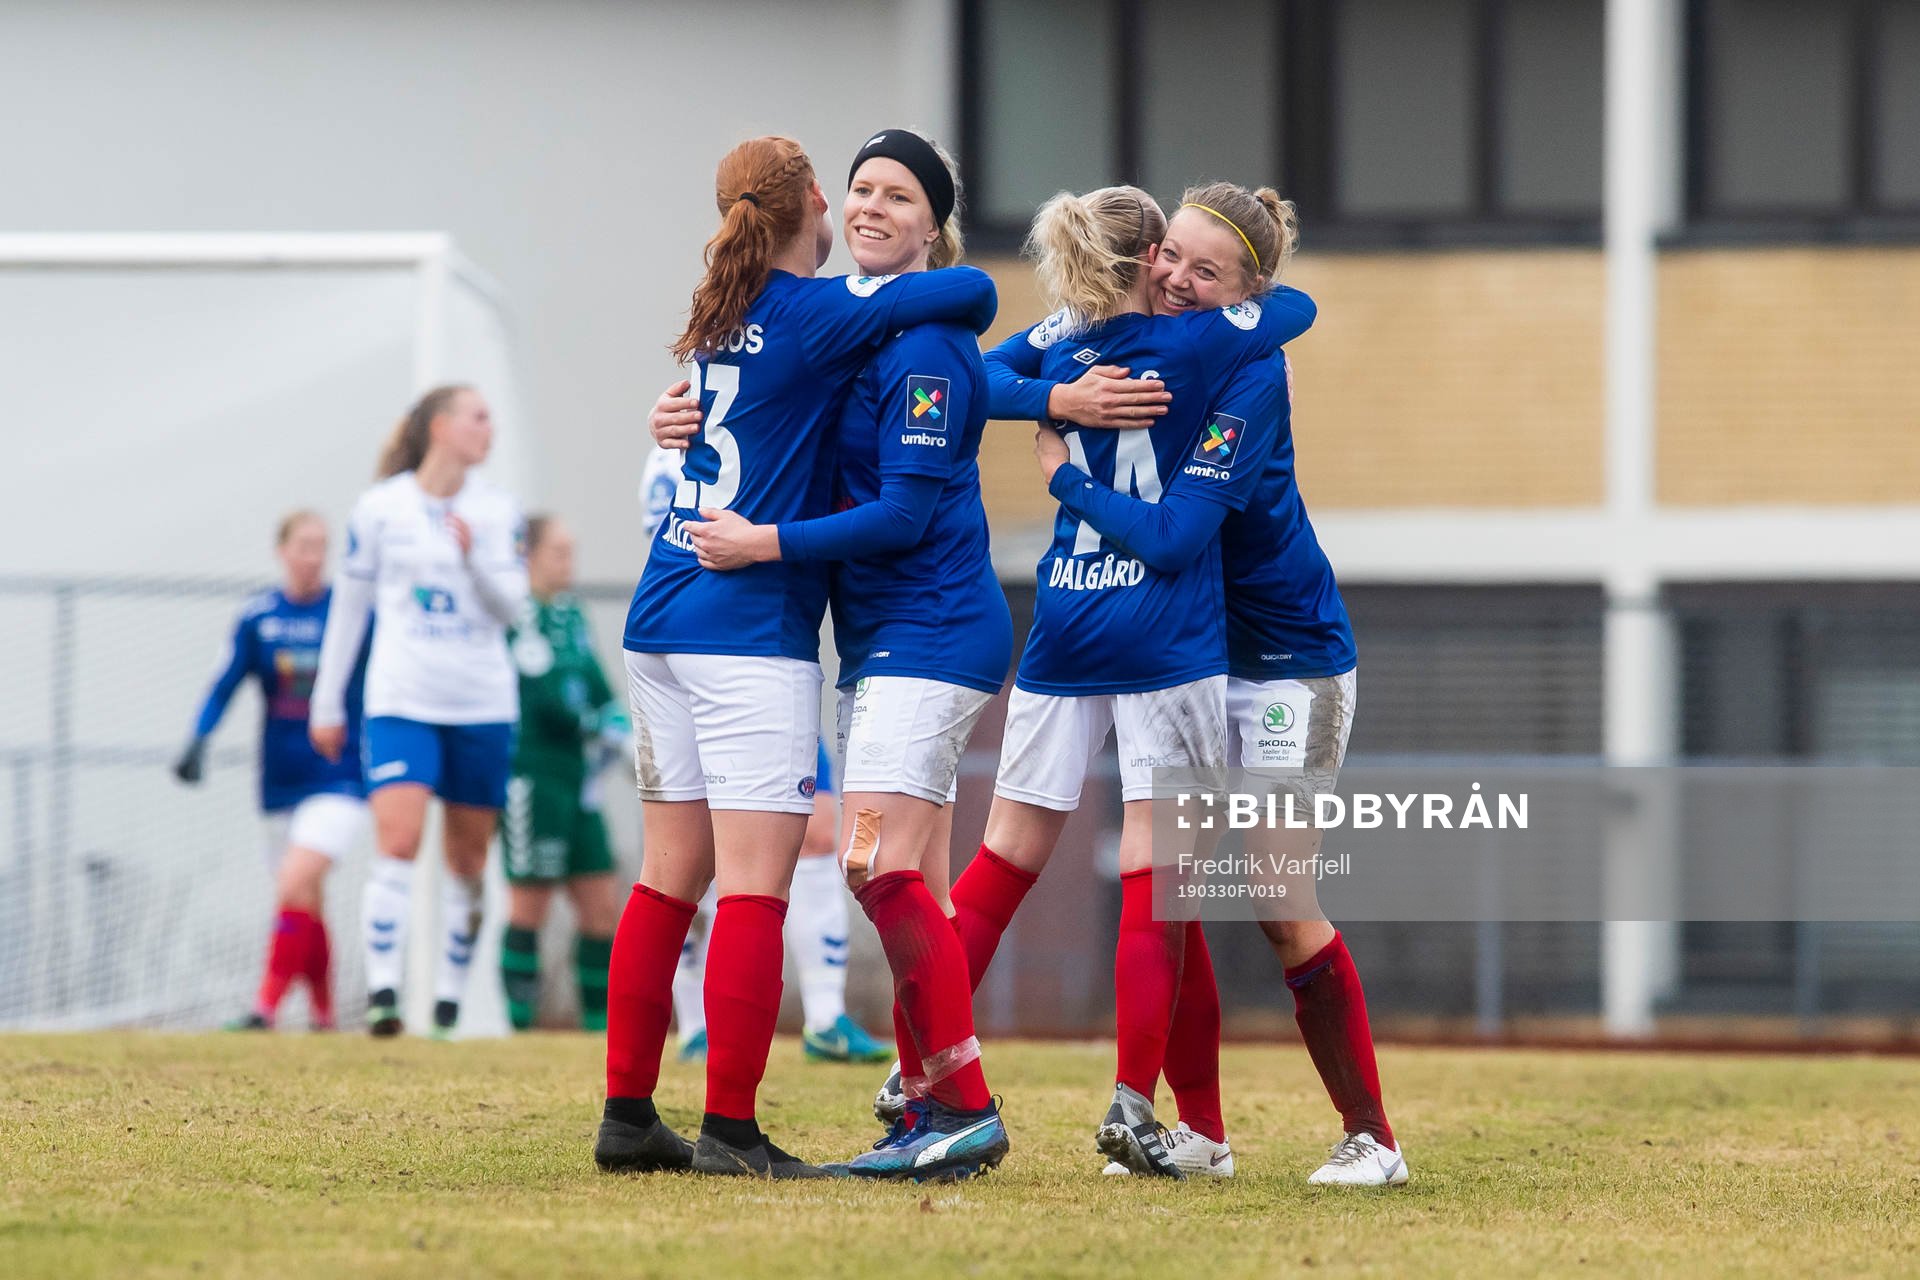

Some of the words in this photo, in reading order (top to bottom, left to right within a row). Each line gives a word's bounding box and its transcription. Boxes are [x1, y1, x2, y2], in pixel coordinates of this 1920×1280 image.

[901, 432, 947, 447] umbro
[1184, 464, 1230, 481] umbro
[1048, 553, 1145, 591] DALGÅRD
